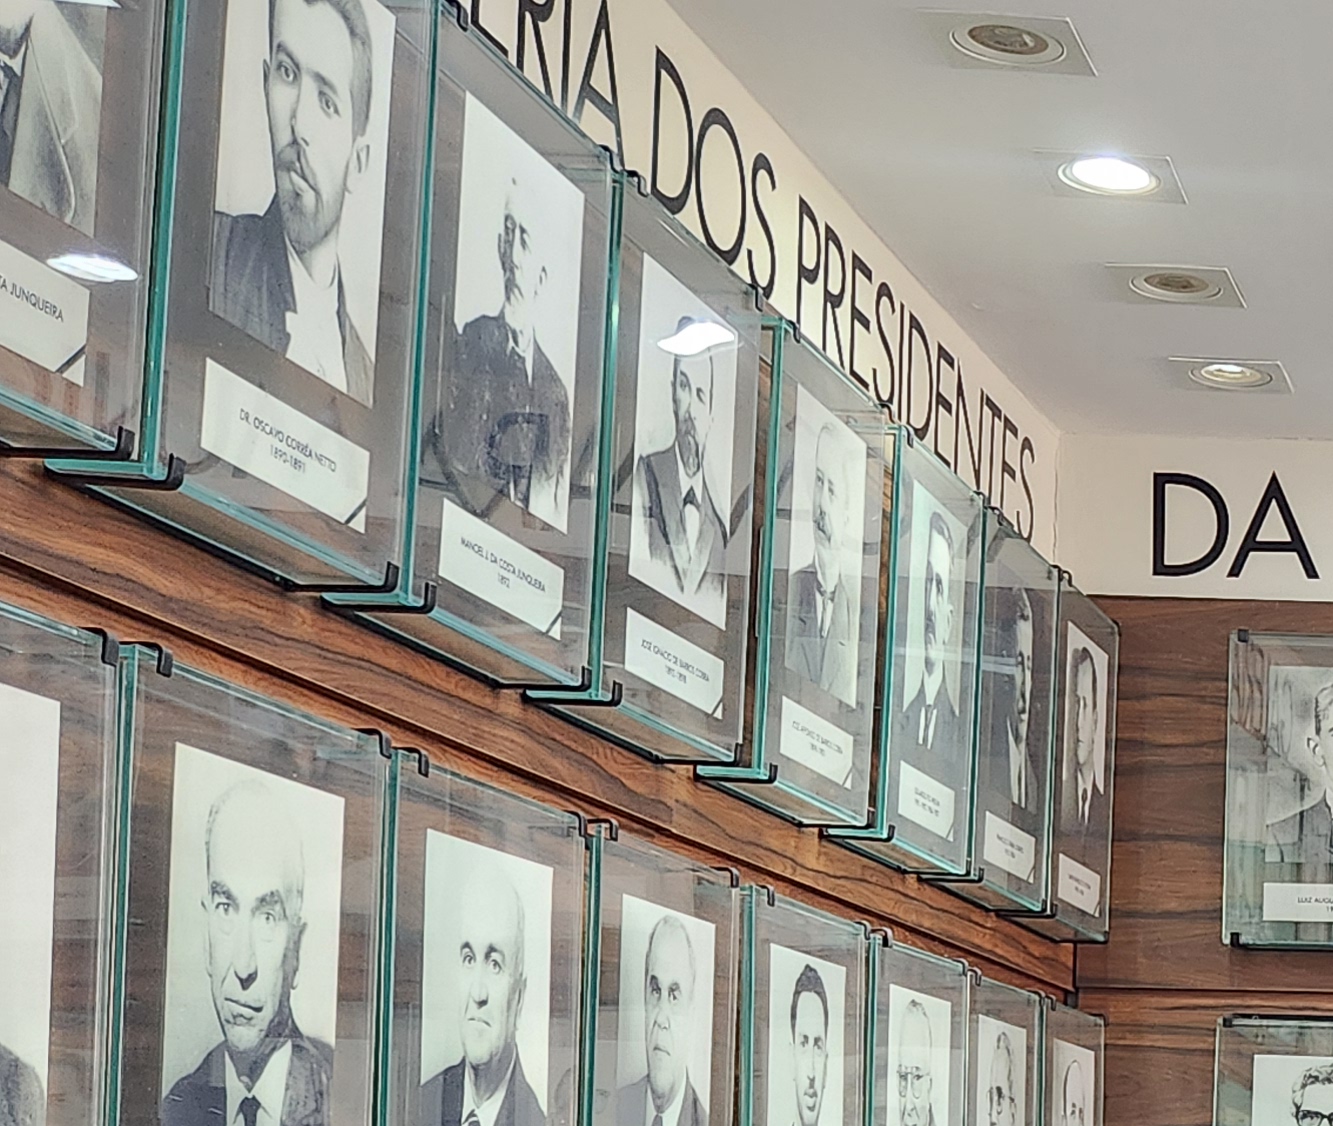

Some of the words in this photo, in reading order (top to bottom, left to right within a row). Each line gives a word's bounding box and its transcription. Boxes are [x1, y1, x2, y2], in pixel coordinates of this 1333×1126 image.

[10, 282, 64, 323] JUNQUEIRA
[651, 44, 776, 300] DOS
[797, 193, 1035, 543] PRESIDENTES
[1151, 471, 1320, 580] DA
[1298, 896, 1312, 905] LUIZ
